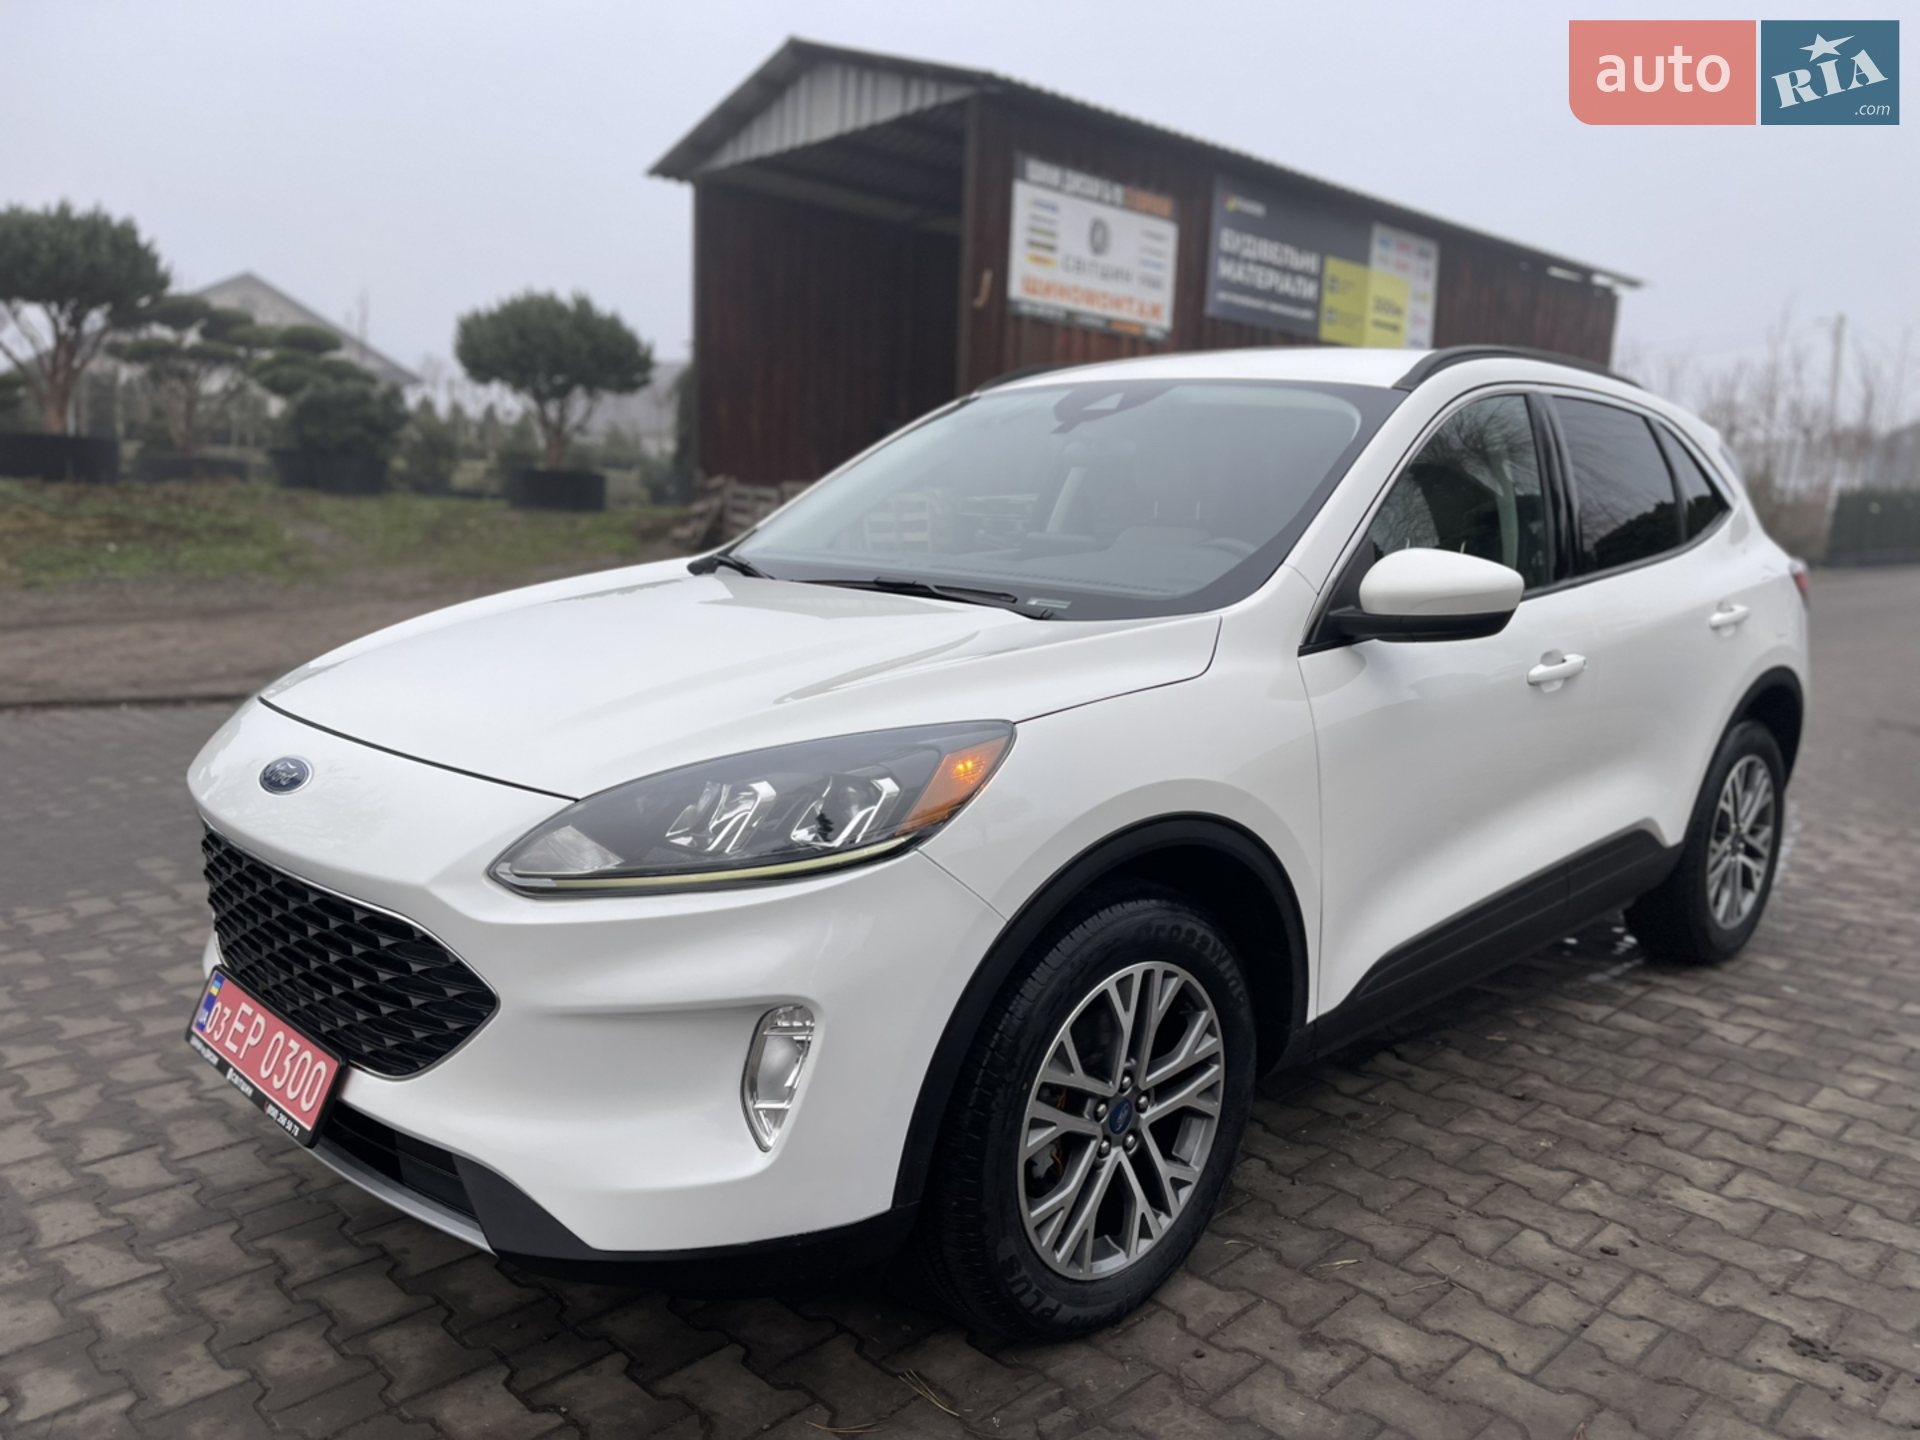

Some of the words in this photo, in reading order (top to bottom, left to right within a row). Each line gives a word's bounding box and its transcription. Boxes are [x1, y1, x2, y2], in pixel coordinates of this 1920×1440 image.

[1220, 228, 1318, 274] БУДІВЕЛЬНІ
[1022, 275, 1163, 320] ШИНОМОНТАЖ
[1217, 257, 1317, 300] МАТЕРІАЛИ
[260, 1031, 327, 1112] 0300
